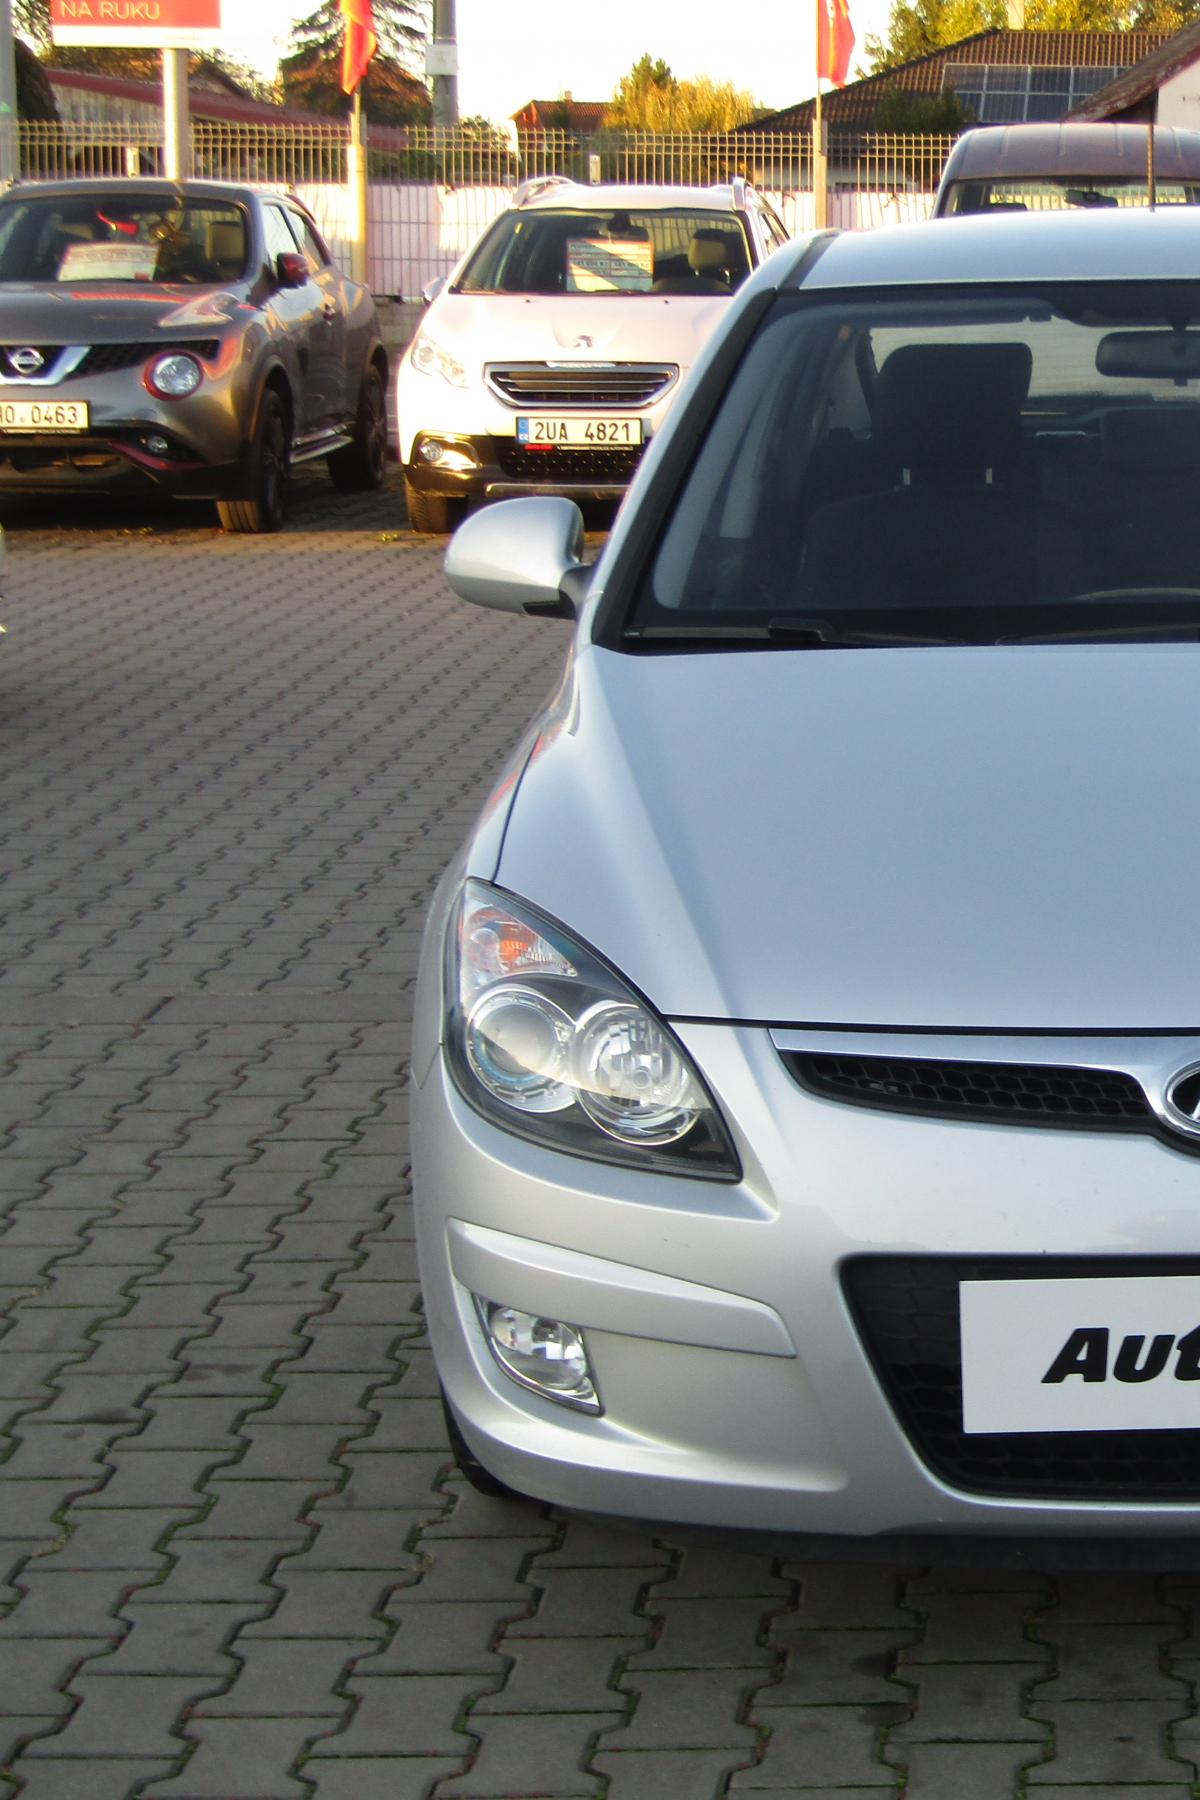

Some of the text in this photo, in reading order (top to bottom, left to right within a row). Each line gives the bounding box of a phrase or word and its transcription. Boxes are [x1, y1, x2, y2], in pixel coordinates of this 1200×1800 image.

[60, 1, 160, 20] NA RUKU
[31, 405, 78, 424] 0463
[535, 422, 630, 441] 2UA 4821
